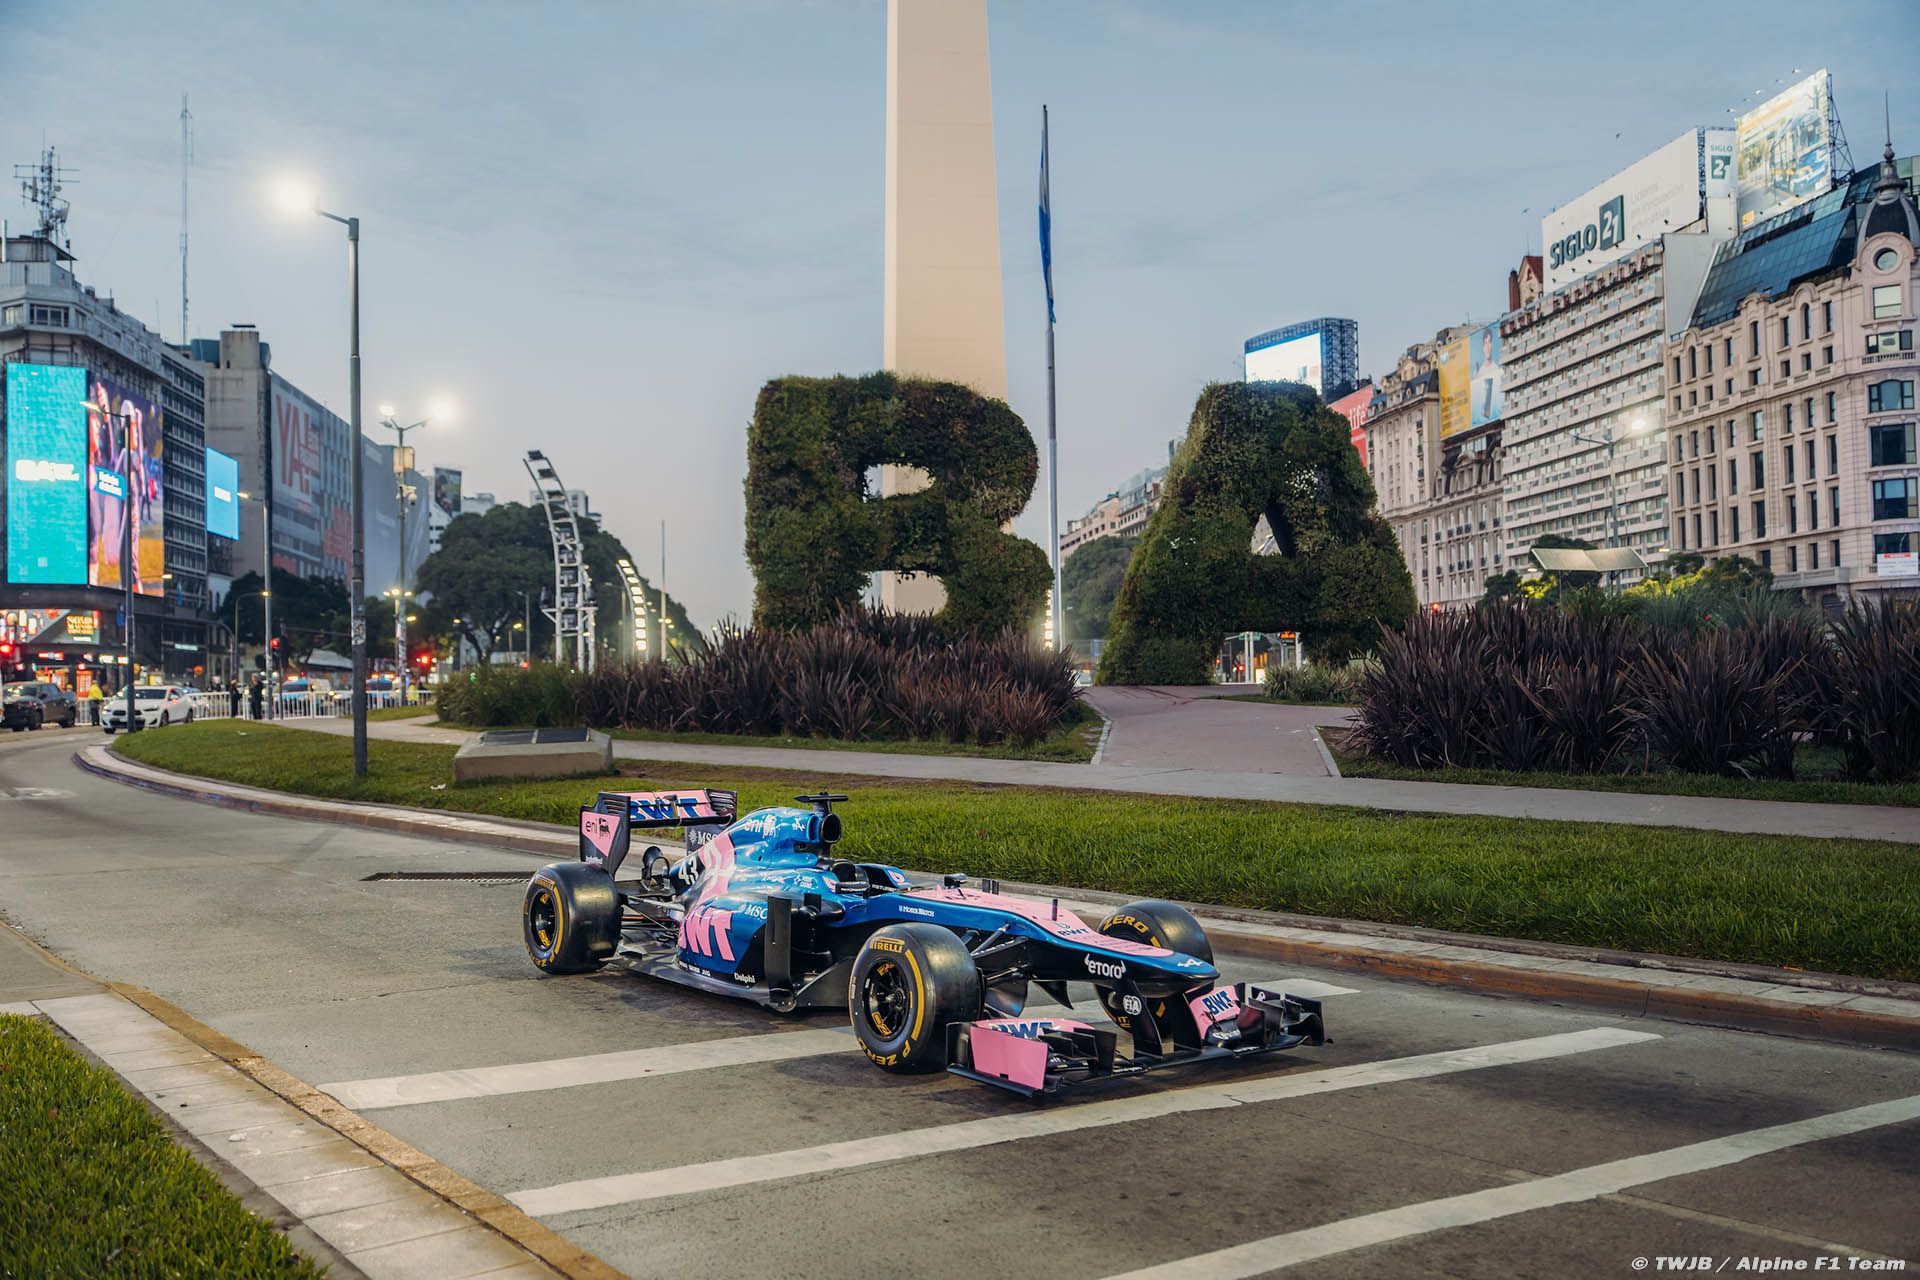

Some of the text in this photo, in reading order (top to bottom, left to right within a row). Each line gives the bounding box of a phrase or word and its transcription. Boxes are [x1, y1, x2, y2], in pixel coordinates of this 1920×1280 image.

[1710, 145, 1733, 153] SIGLO
[1550, 210, 1621, 270] SIGLO 21
[585, 820, 598, 833] eni
[744, 815, 764, 833] eni
[678, 855, 699, 885] 43
[745, 903, 768, 920] MSC
[1103, 914, 1149, 934] ZERO
[734, 972, 755, 984] Delphi
[1202, 990, 1233, 1015] BWT
[902, 1040, 911, 1058] P
